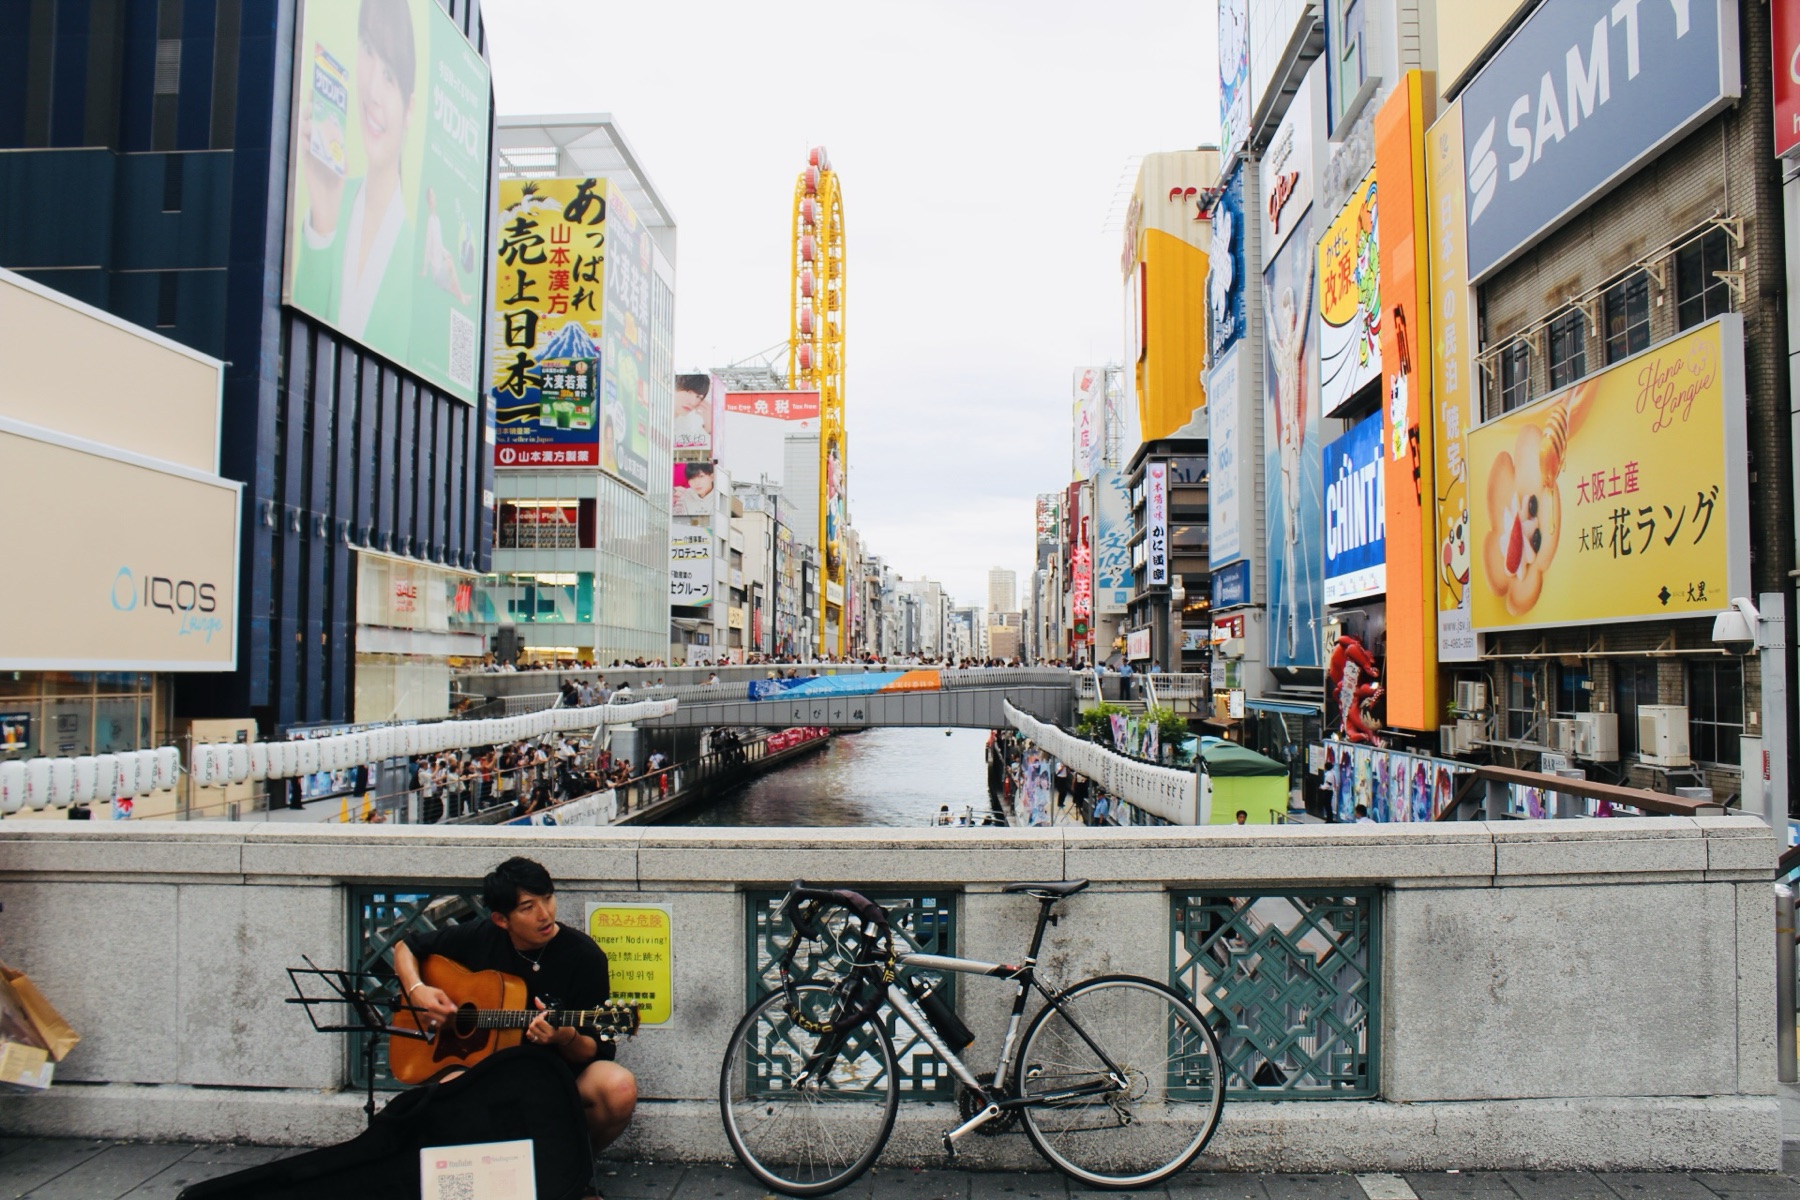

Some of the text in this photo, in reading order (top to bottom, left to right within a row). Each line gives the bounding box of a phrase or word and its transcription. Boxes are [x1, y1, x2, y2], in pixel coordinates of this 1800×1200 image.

[433, 83, 480, 163] サロンパス
[563, 178, 605, 312] あっぱれ
[1327, 227, 1348, 268] かぜに
[548, 223, 570, 314] 山本漢方
[1324, 249, 1352, 315] 改源
[543, 374, 587, 390] 大麦若葉
[1636, 358, 1684, 413] Hana
[1652, 375, 1715, 432] Langue
[754, 399, 789, 414] 免税
[518, 450, 589, 463] 山本漢方製薬
[1577, 460, 1639, 507] 大阪土産
[1579, 485, 1719, 558] 大阪 花ラング
[1152, 525, 1165, 581] かに道楽
[144, 576, 216, 614] IQOS
[396, 584, 417, 599] SALE
[1686, 581, 1707, 602] 大黒
[793, 708, 864, 720] えびす橋
[598, 913, 662, 927] 飛込み危険
